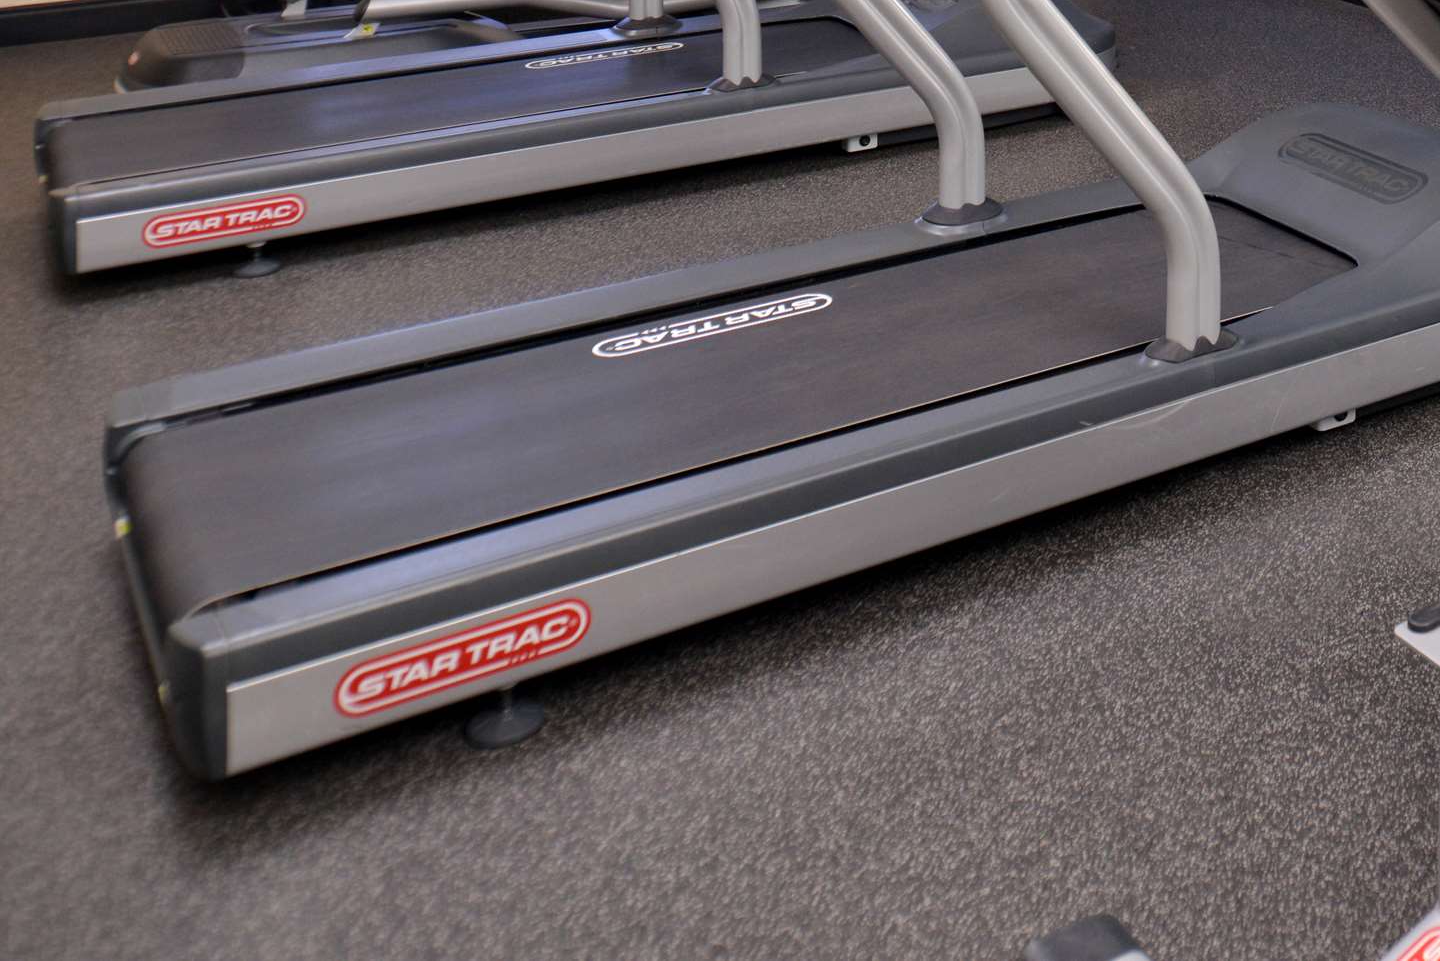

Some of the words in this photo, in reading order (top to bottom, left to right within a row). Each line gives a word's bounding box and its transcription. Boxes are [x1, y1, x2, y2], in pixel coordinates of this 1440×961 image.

[538, 53, 609, 67] TRAC
[612, 43, 674, 56] STAR
[156, 215, 221, 238] STAR
[225, 204, 293, 226] TRAC
[725, 298, 817, 325] STAR
[614, 321, 721, 351] TRAC
[355, 649, 461, 697] STAR
[465, 615, 571, 663] TRAC
